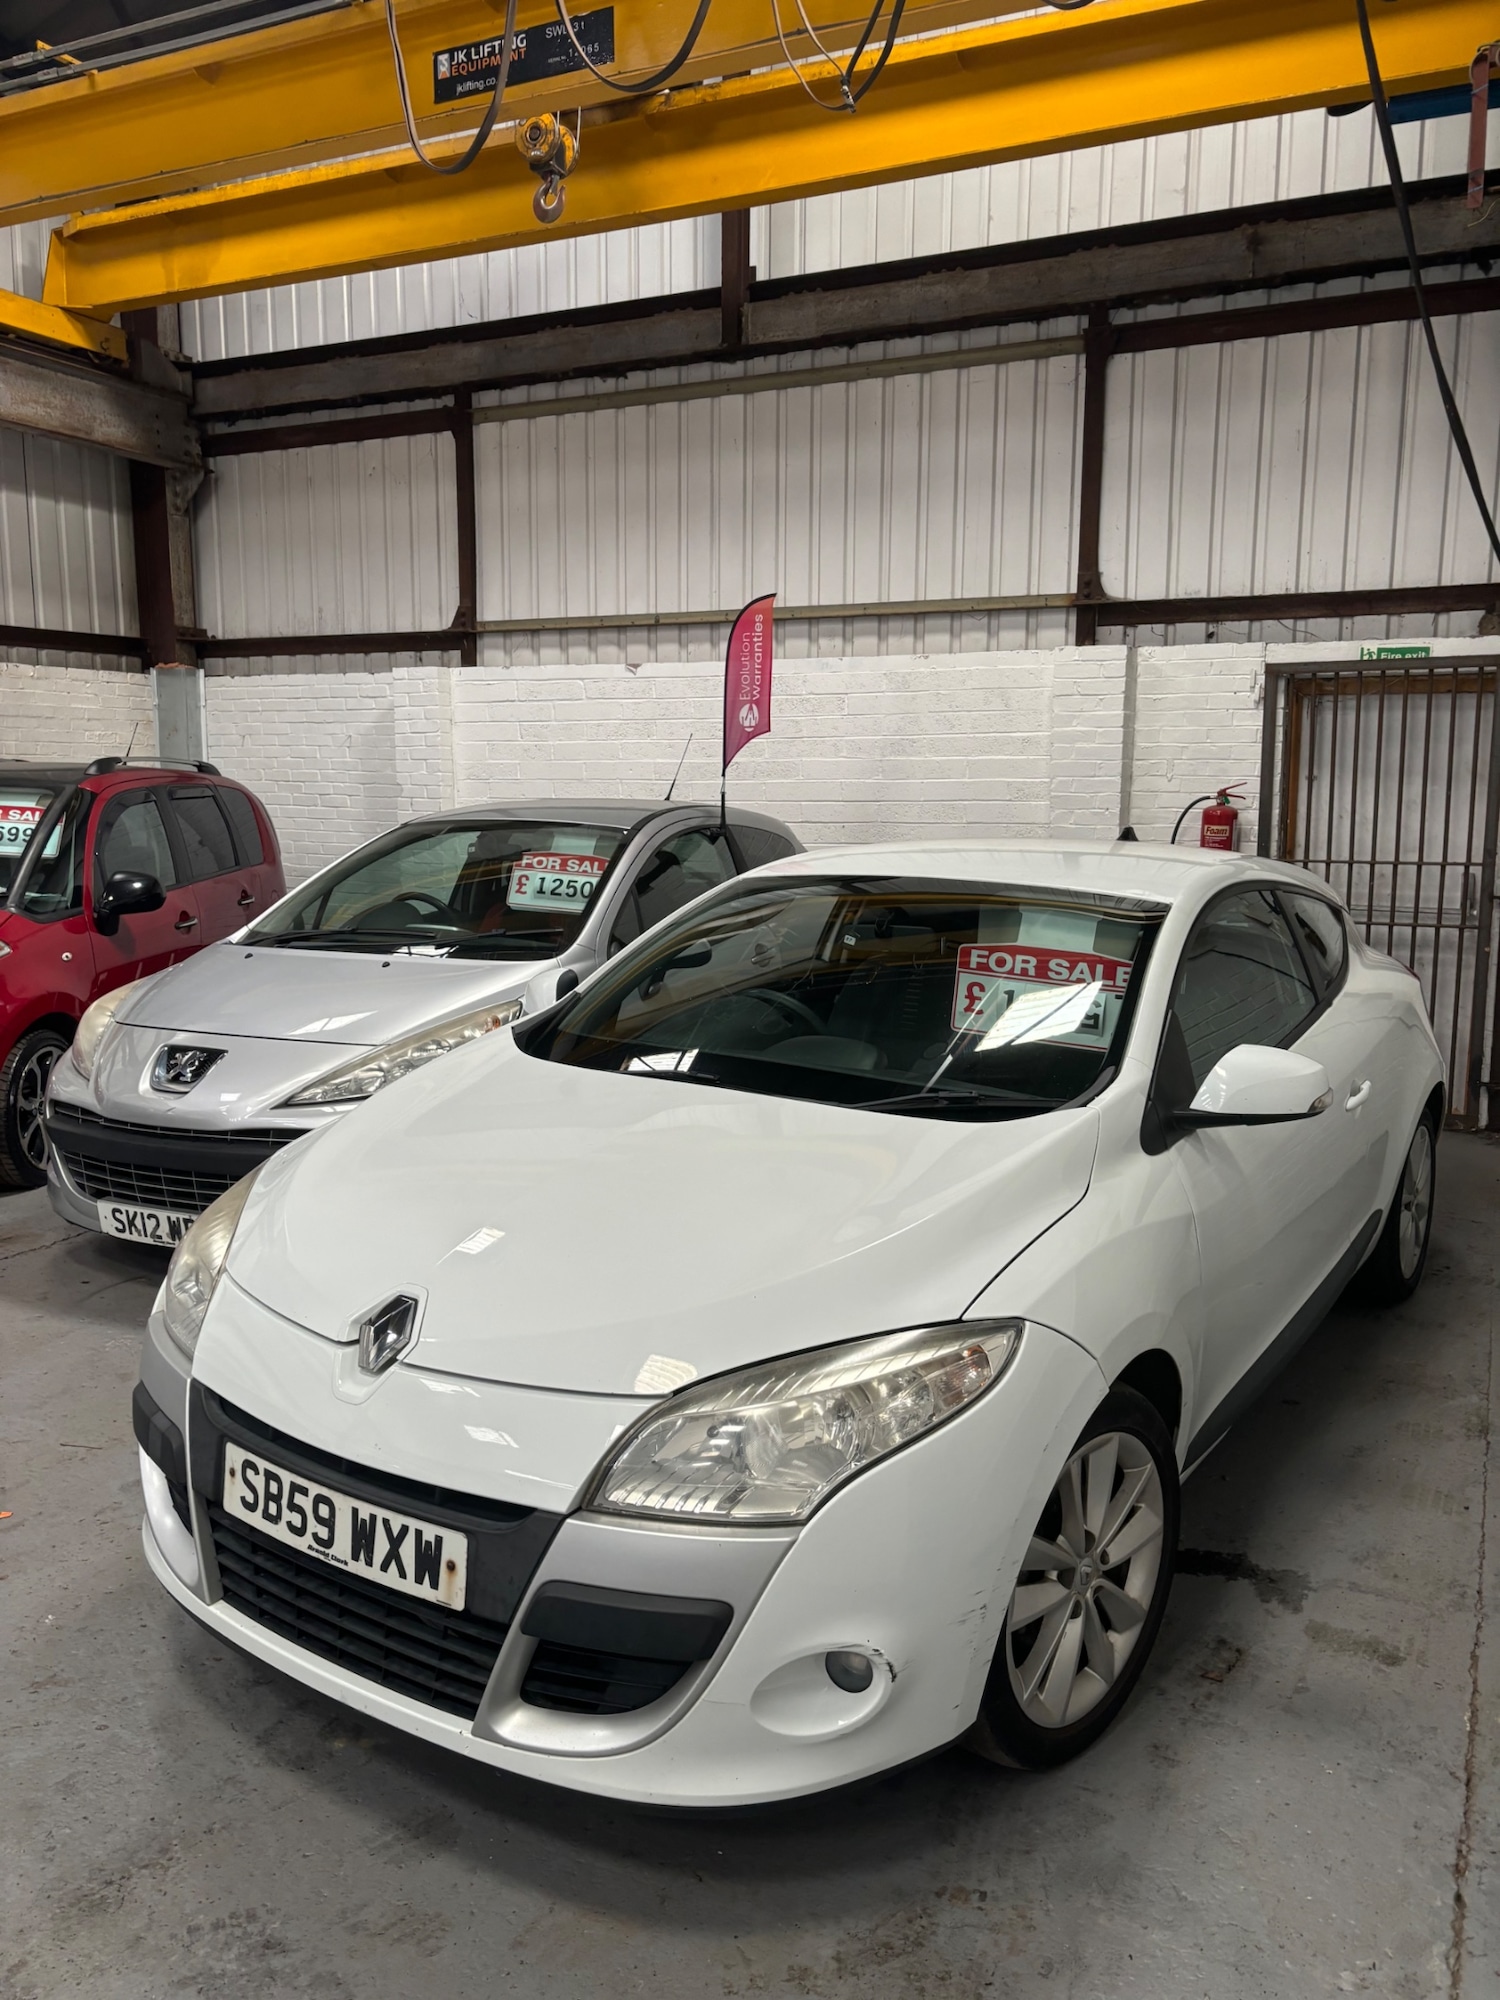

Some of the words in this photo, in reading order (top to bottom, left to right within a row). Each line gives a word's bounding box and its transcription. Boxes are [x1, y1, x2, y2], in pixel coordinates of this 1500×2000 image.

[451, 47, 527, 76] EQUIPMNT
[452, 49, 467, 65] JK
[739, 632, 751, 700] Evolution
[752, 614, 763, 700] Warranties
[8, 809, 41, 821] SAL
[1205, 826, 1228, 835] Foam
[521, 855, 561, 870] FOR
[566, 860, 609, 874] SAL
[969, 949, 1037, 976] FOR
[1047, 958, 1132, 987] SALE
[111, 1207, 163, 1240] SK12
[240, 1458, 336, 1550] SB59
[351, 1506, 443, 1591] WXW
